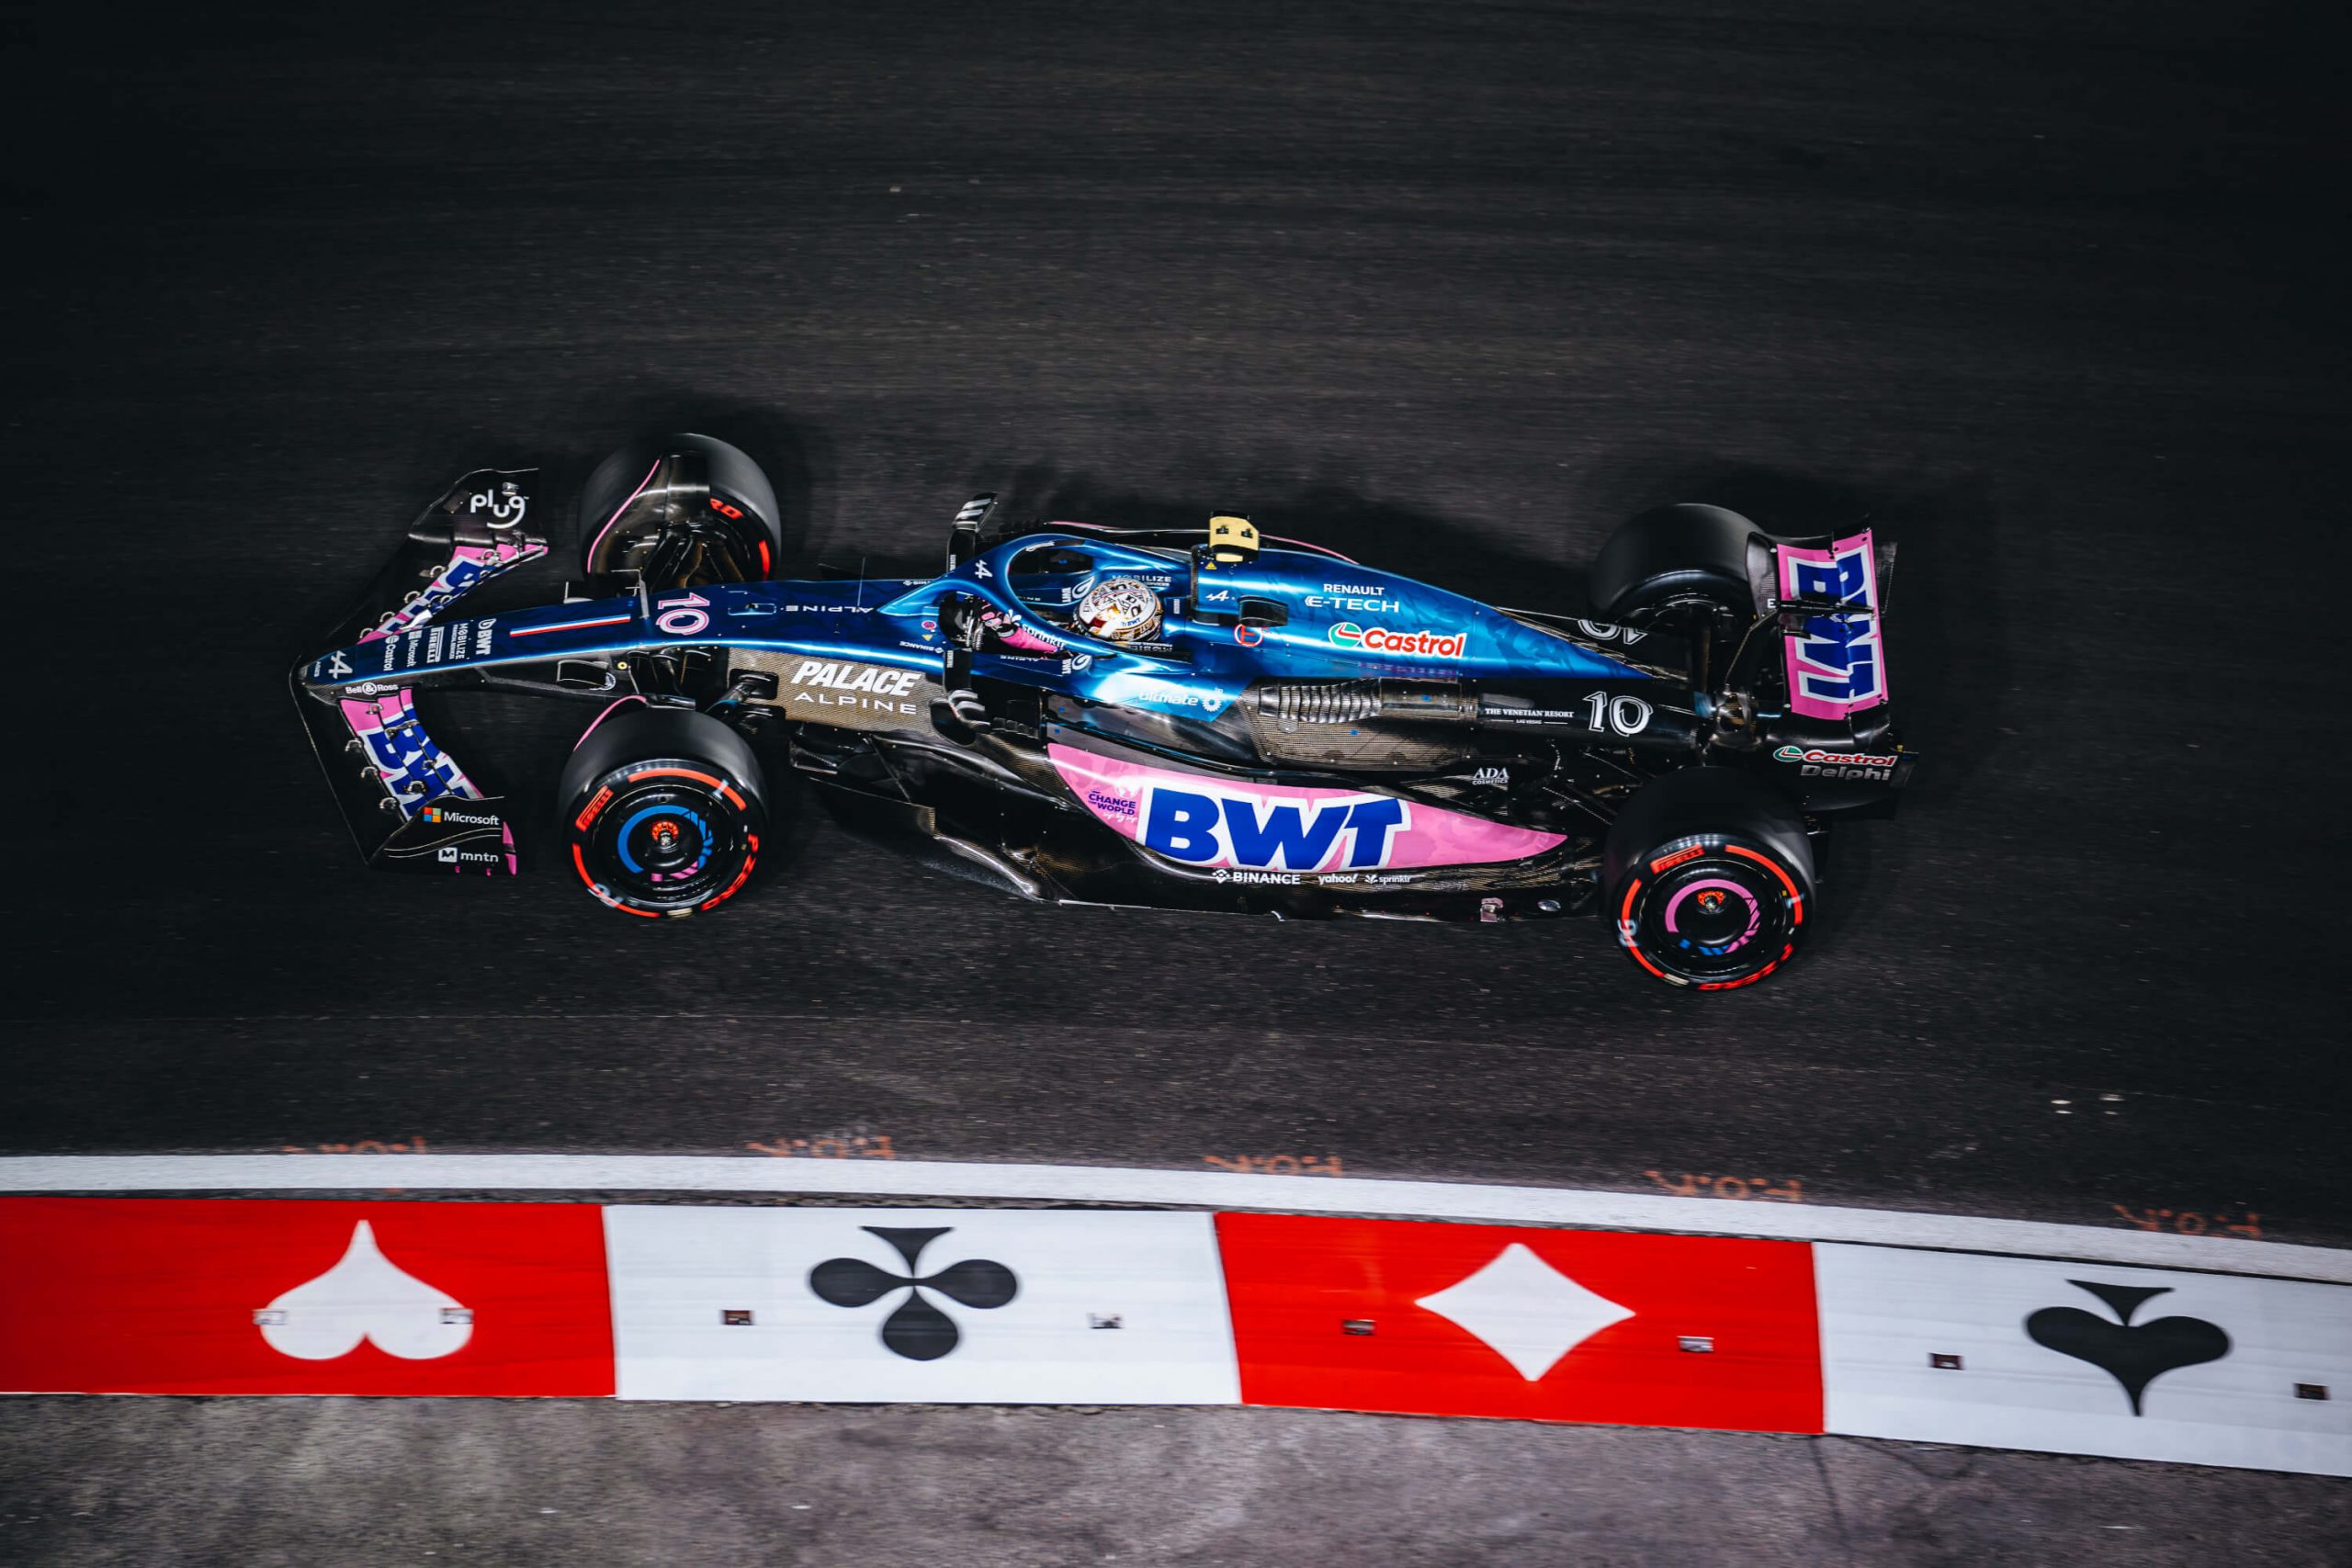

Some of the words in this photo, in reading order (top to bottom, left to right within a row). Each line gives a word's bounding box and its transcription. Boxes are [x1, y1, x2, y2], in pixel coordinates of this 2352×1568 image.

[470, 489, 526, 529] plug
[1323, 584, 1385, 596] RENAULT
[786, 605, 875, 614] ALPINE
[1305, 595, 1400, 613] E-TECH
[656, 592, 710, 636] 10
[426, 626, 445, 663] PIRELLI
[476, 629, 492, 655] BWT
[899, 641, 934, 652] BINANCE
[1362, 626, 1467, 659] Castrol
[383, 643, 397, 671] Castrol
[407, 638, 419, 668] Microsoft
[790, 660, 922, 697] PALACE
[345, 686, 362, 694] Bell
[378, 683, 399, 692] Ross
[793, 691, 917, 715] ALPINE
[1485, 707, 1500, 716] THE
[1503, 708, 1544, 717] VENETIAN
[1544, 710, 1575, 718] RESORT
[1582, 691, 1654, 737] 10
[1804, 750, 1898, 766] Castrol
[1473, 767, 1510, 779] ADA
[1801, 764, 1892, 781] Delphi
[1089, 793, 1136, 808] CHANGE
[1097, 802, 1136, 816] WORLD
[444, 810, 500, 826] Microsoft
[1142, 784, 1406, 874] BWT
[460, 851, 499, 863] mntn
[1233, 871, 1301, 885] BINANCE
[1317, 873, 1359, 885] yahoo!
[1378, 874, 1412, 884] sprinklr
